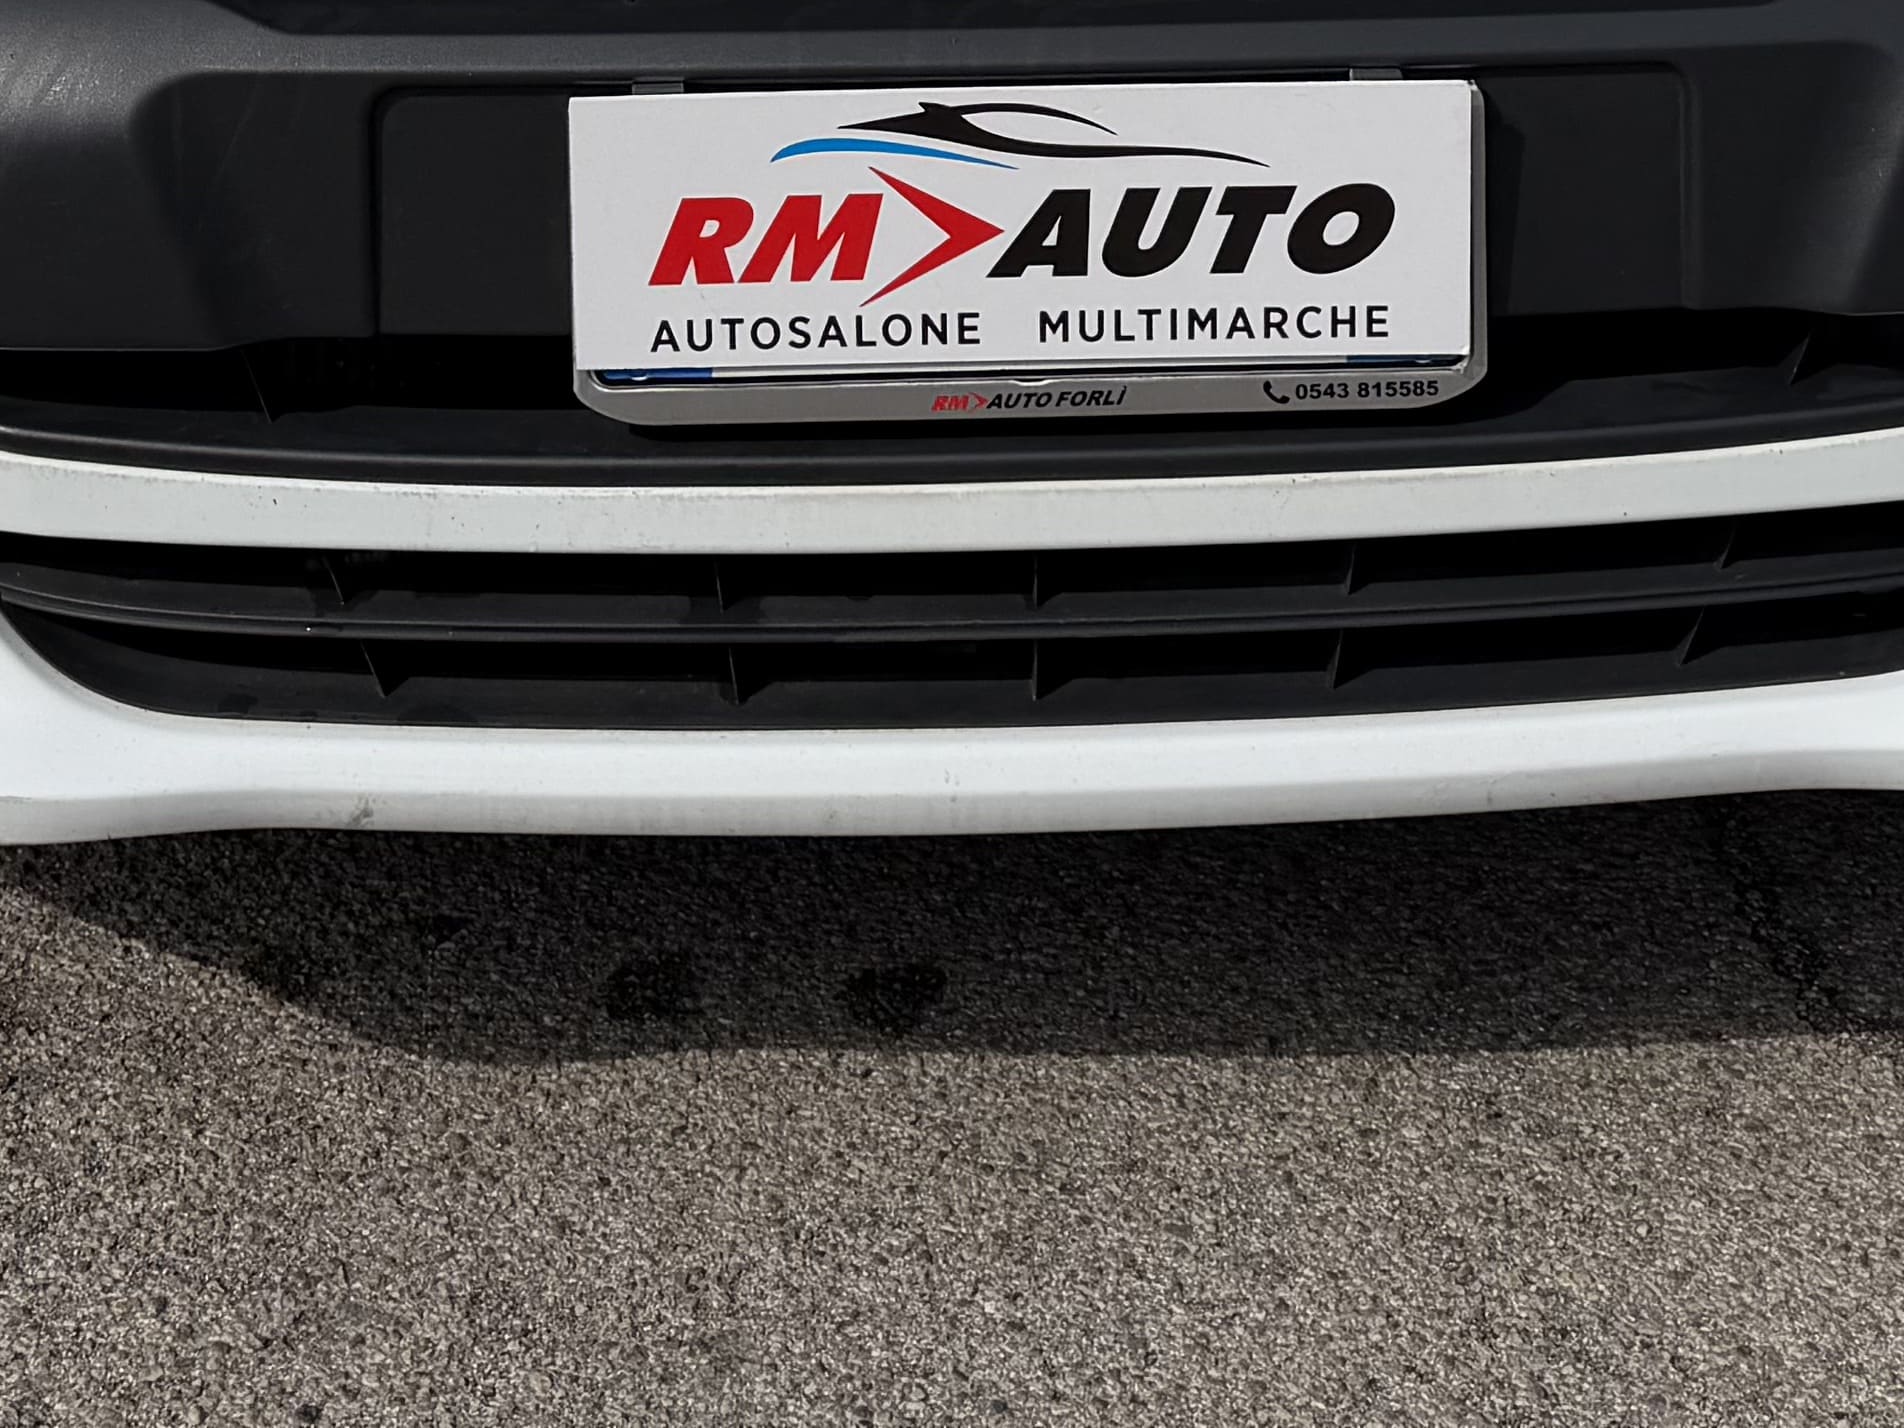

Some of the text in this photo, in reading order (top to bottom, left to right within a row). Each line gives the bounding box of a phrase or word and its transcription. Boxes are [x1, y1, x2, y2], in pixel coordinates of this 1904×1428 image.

[647, 182, 1397, 286] RM AUTO
[649, 304, 1392, 354] AUTOSALONE MULTIMARCHE
[930, 394, 970, 413] RM
[986, 392, 1053, 410] AUTO
[1295, 379, 1440, 401] 0543 815585
